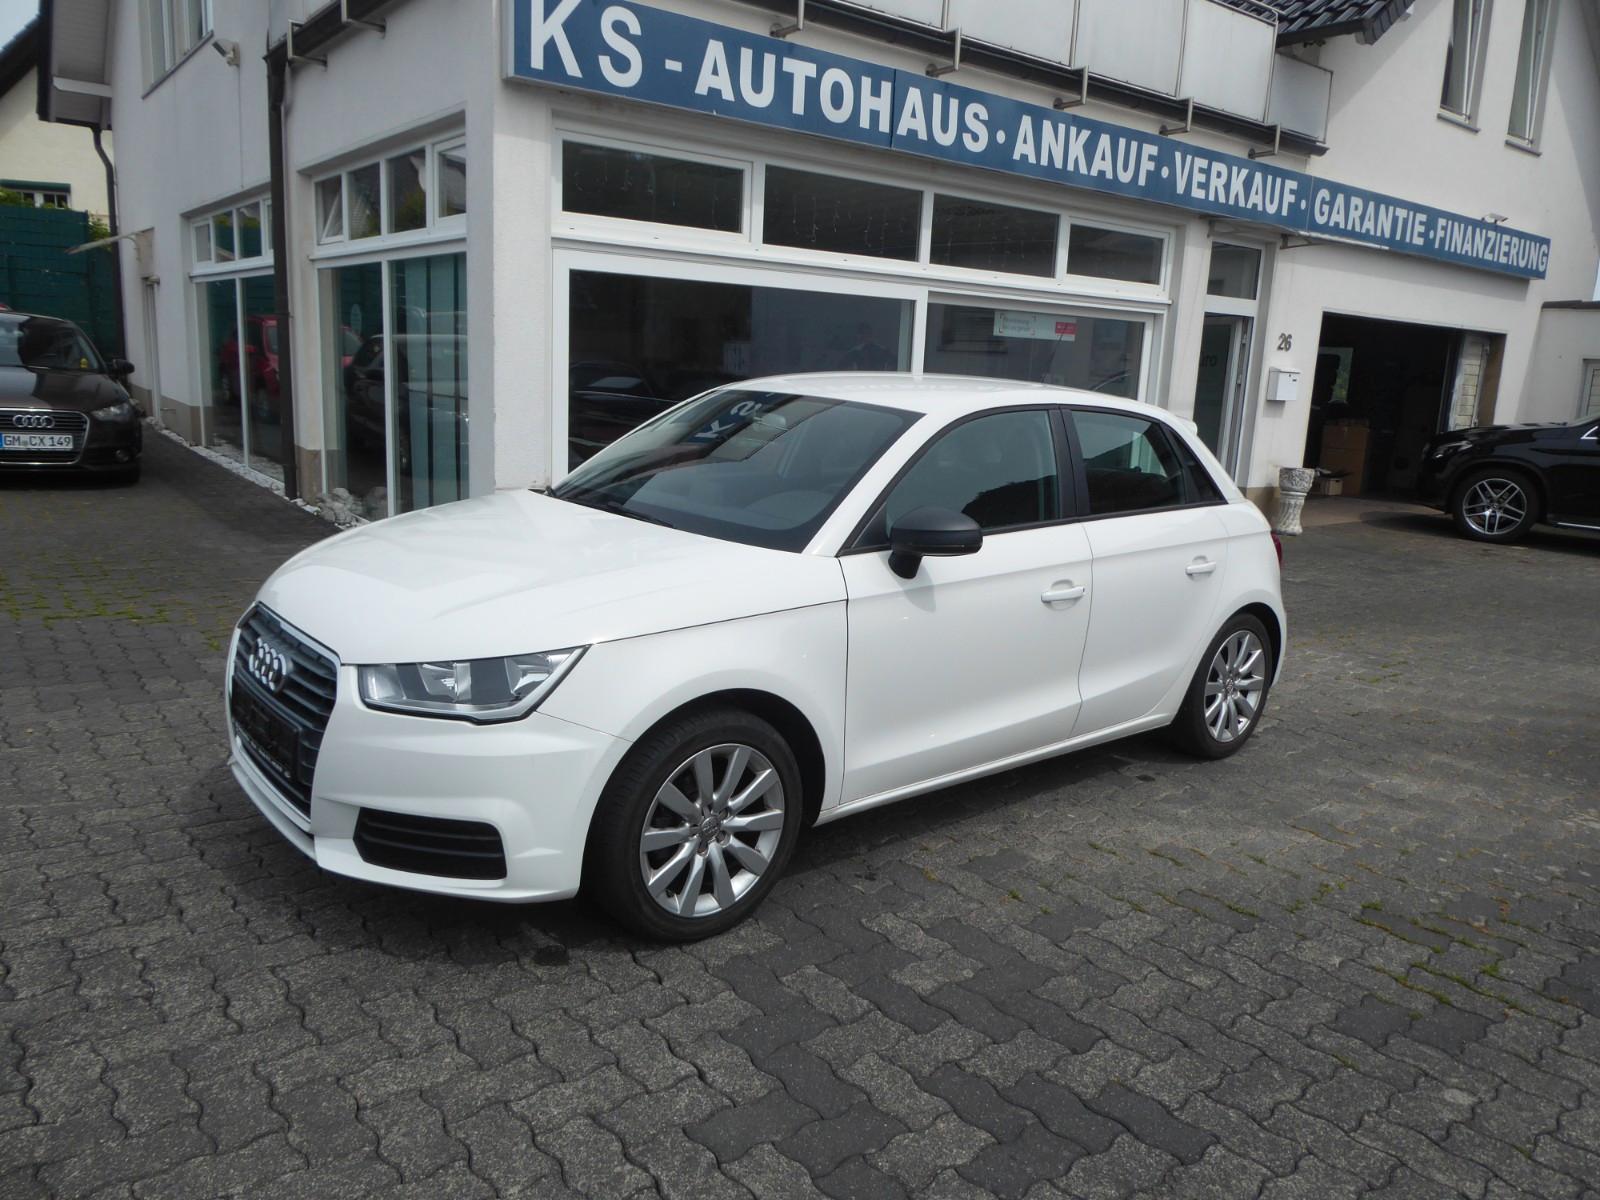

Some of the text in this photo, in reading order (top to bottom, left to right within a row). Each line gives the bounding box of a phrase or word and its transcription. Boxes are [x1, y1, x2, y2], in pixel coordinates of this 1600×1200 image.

[530, 0, 643, 88] KS
[694, 39, 989, 153] AUTOHAUS
[1012, 114, 1158, 187] ANKAUF
[1174, 151, 1298, 216] VERKAUF
[1314, 188, 1428, 246] GARANTIE
[1434, 217, 1548, 272] FINANZIERUNG
[1277, 332, 1293, 352] 26
